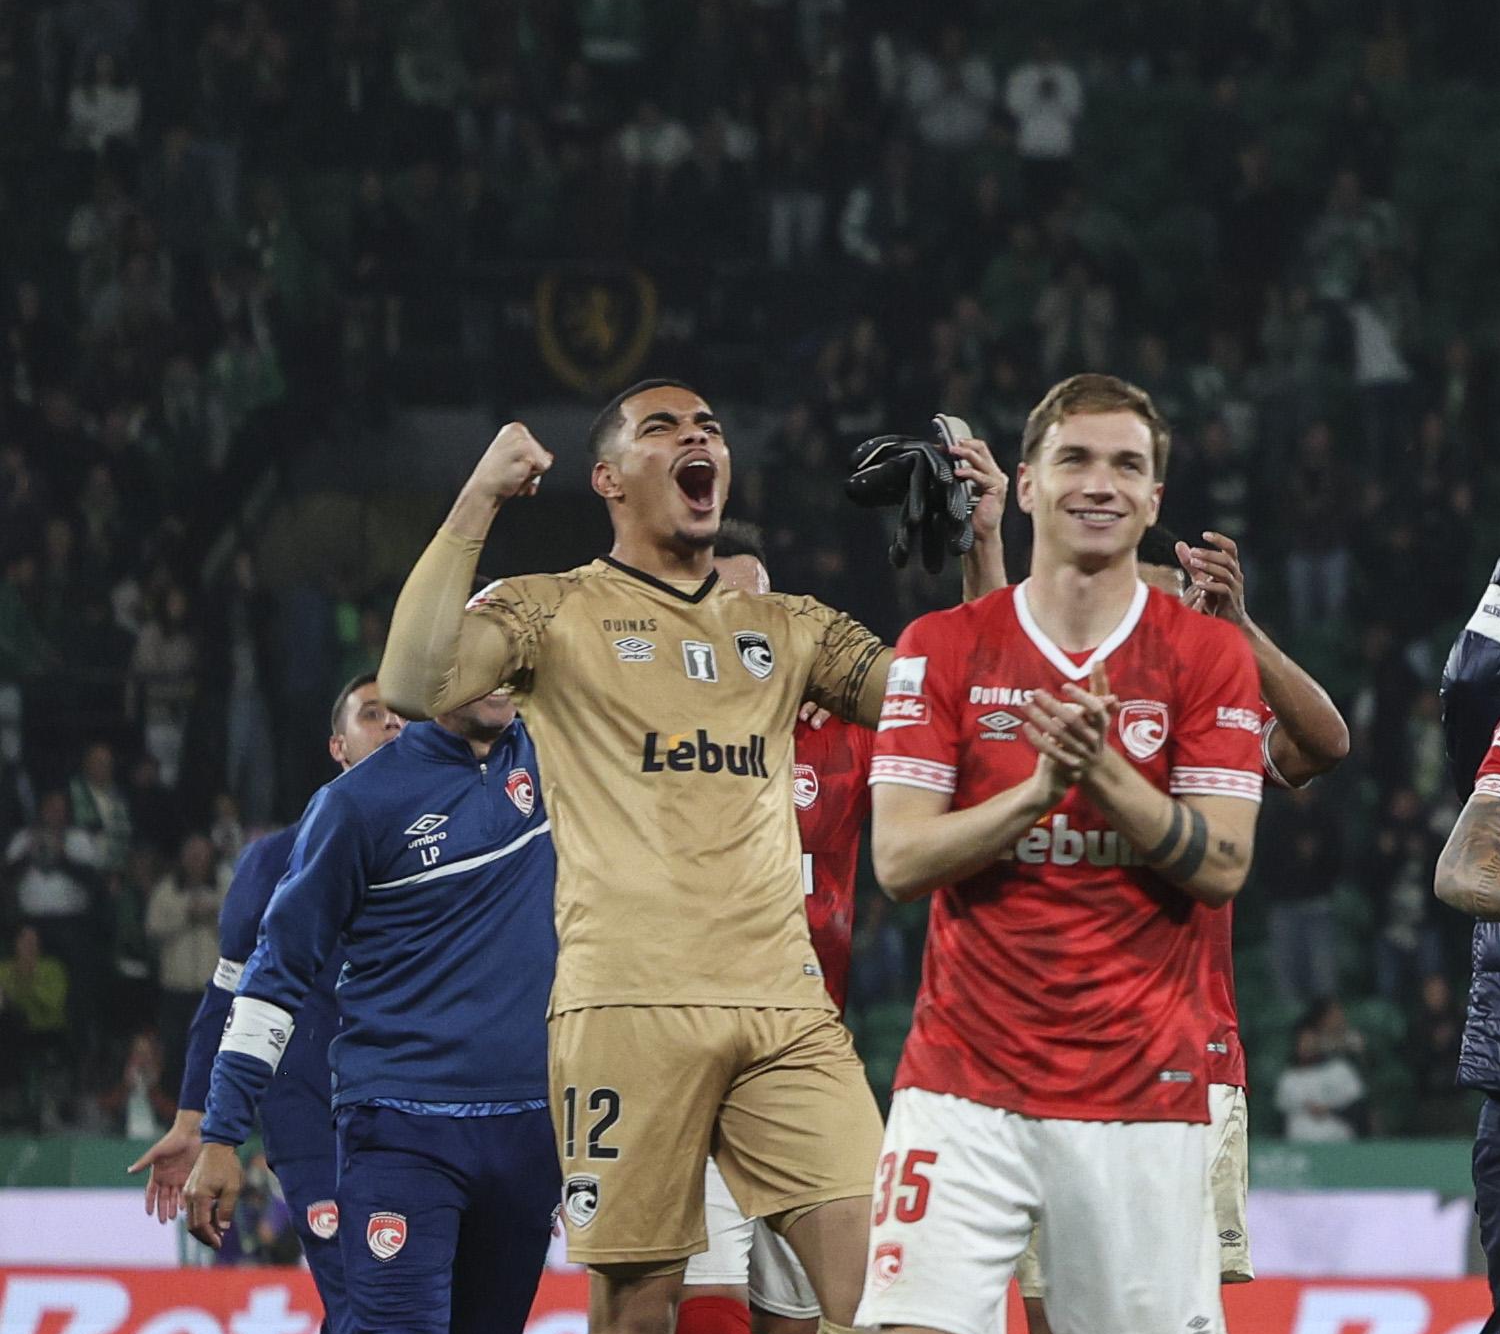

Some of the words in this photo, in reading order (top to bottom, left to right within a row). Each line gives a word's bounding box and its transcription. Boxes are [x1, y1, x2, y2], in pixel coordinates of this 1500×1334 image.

[408, 832, 448, 850] umbro
[420, 847, 442, 867] LP
[564, 1086, 621, 1159] 12
[875, 1148, 938, 1227] 35
